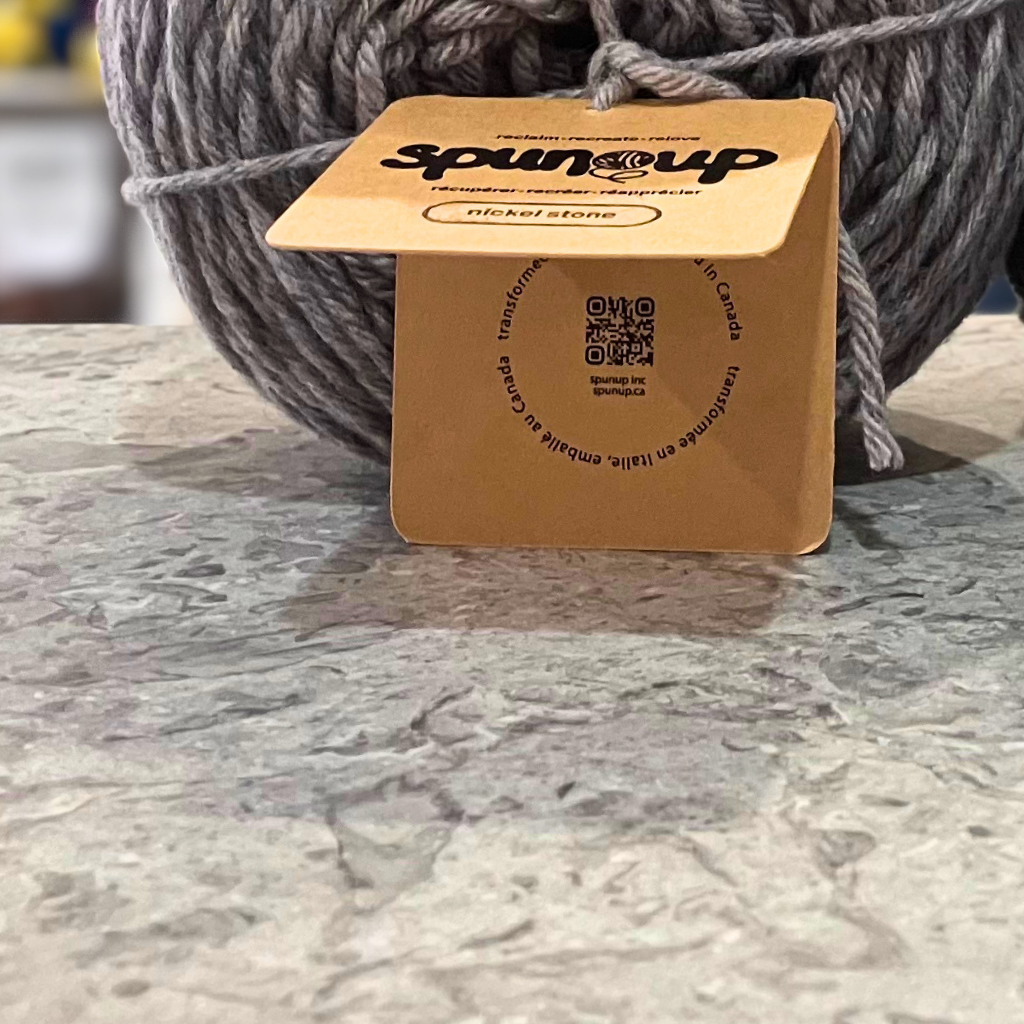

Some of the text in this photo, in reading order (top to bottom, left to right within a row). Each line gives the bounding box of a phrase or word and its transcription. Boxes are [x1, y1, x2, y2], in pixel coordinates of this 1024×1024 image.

[467, 207, 617, 219] nickel stone
[716, 282, 743, 341] Canada
[496, 355, 526, 413] Canada
[590, 375, 646, 386] spunup inc
[593, 387, 646, 398] spunup.ca
[678, 366, 740, 446] transformée
[524, 414, 543, 432] au
[540, 431, 602, 465] emballé
[656, 445, 676, 459] en
